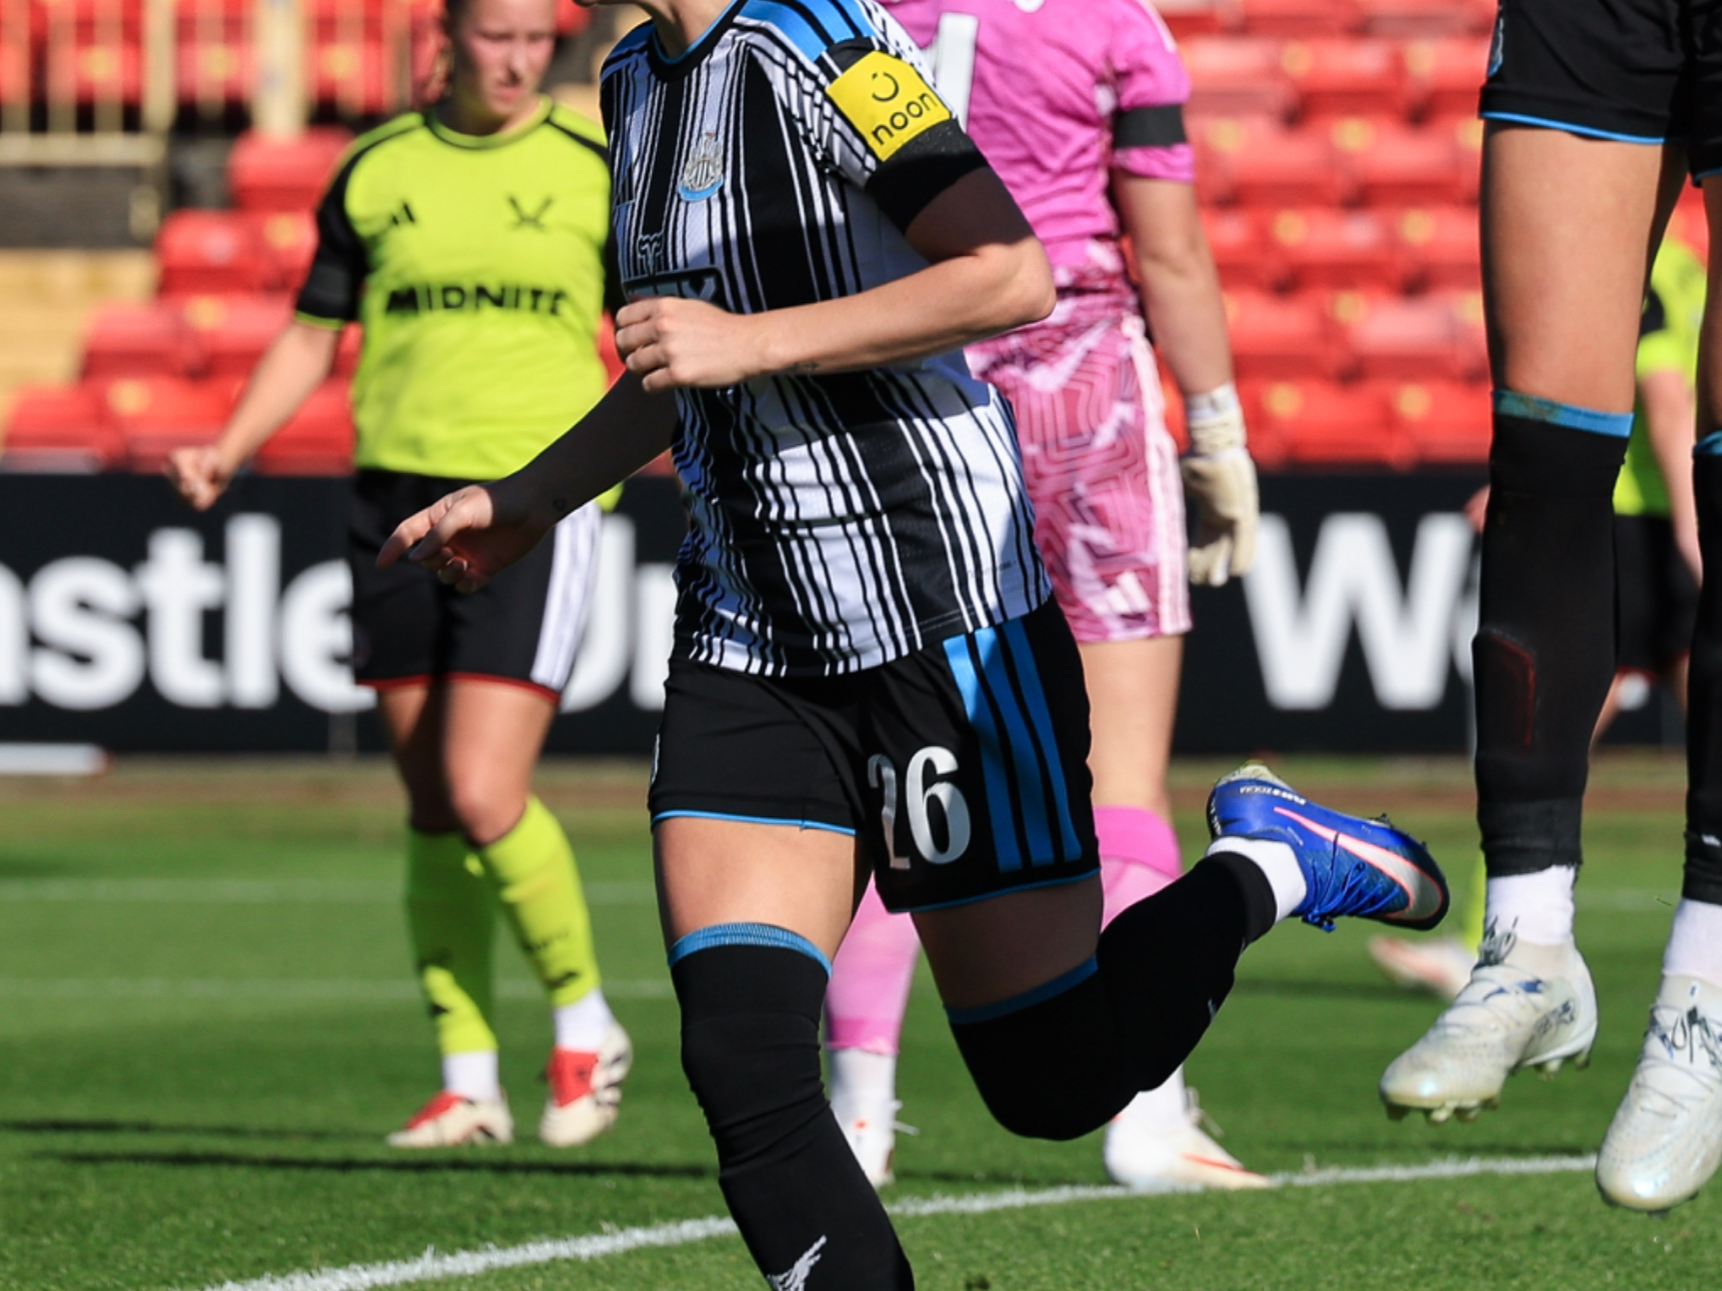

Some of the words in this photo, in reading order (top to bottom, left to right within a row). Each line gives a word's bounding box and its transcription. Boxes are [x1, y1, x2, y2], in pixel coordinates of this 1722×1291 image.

[871, 92, 938, 146] noon
[0, 512, 378, 711] stle
[867, 745, 971, 869] 26
